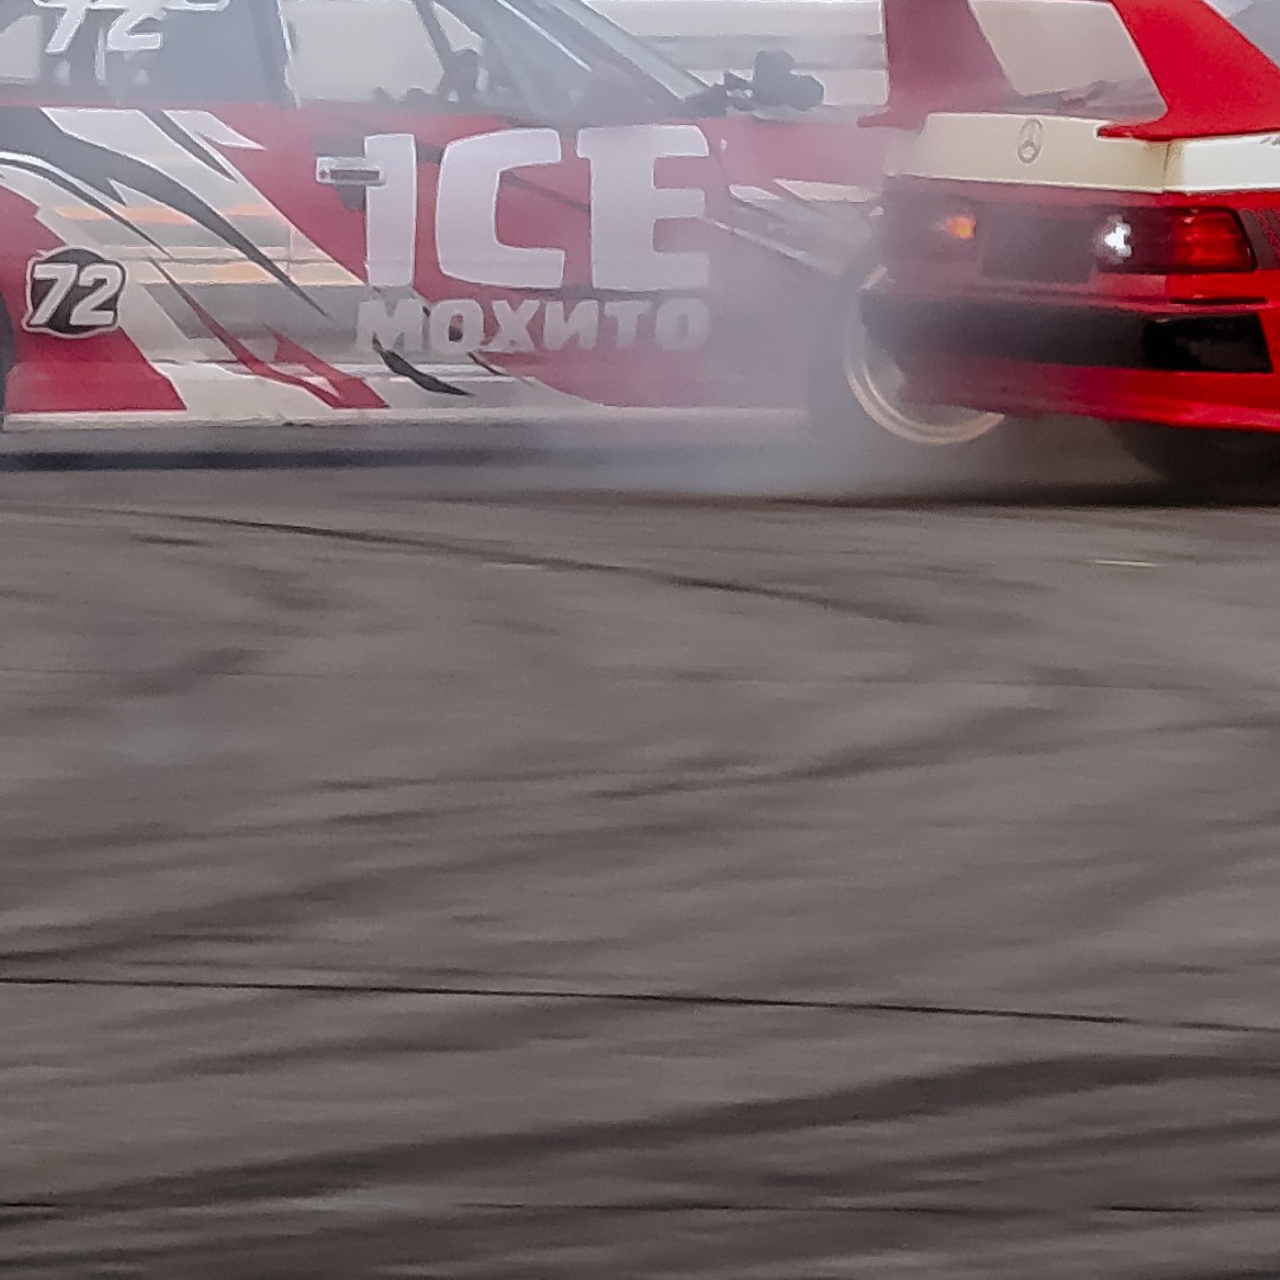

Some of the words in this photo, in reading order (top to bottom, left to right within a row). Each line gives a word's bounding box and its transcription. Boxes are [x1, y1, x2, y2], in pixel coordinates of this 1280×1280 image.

[364, 124, 710, 291] ICE
[26, 263, 122, 325] 72
[356, 298, 710, 352] МОХИТО
